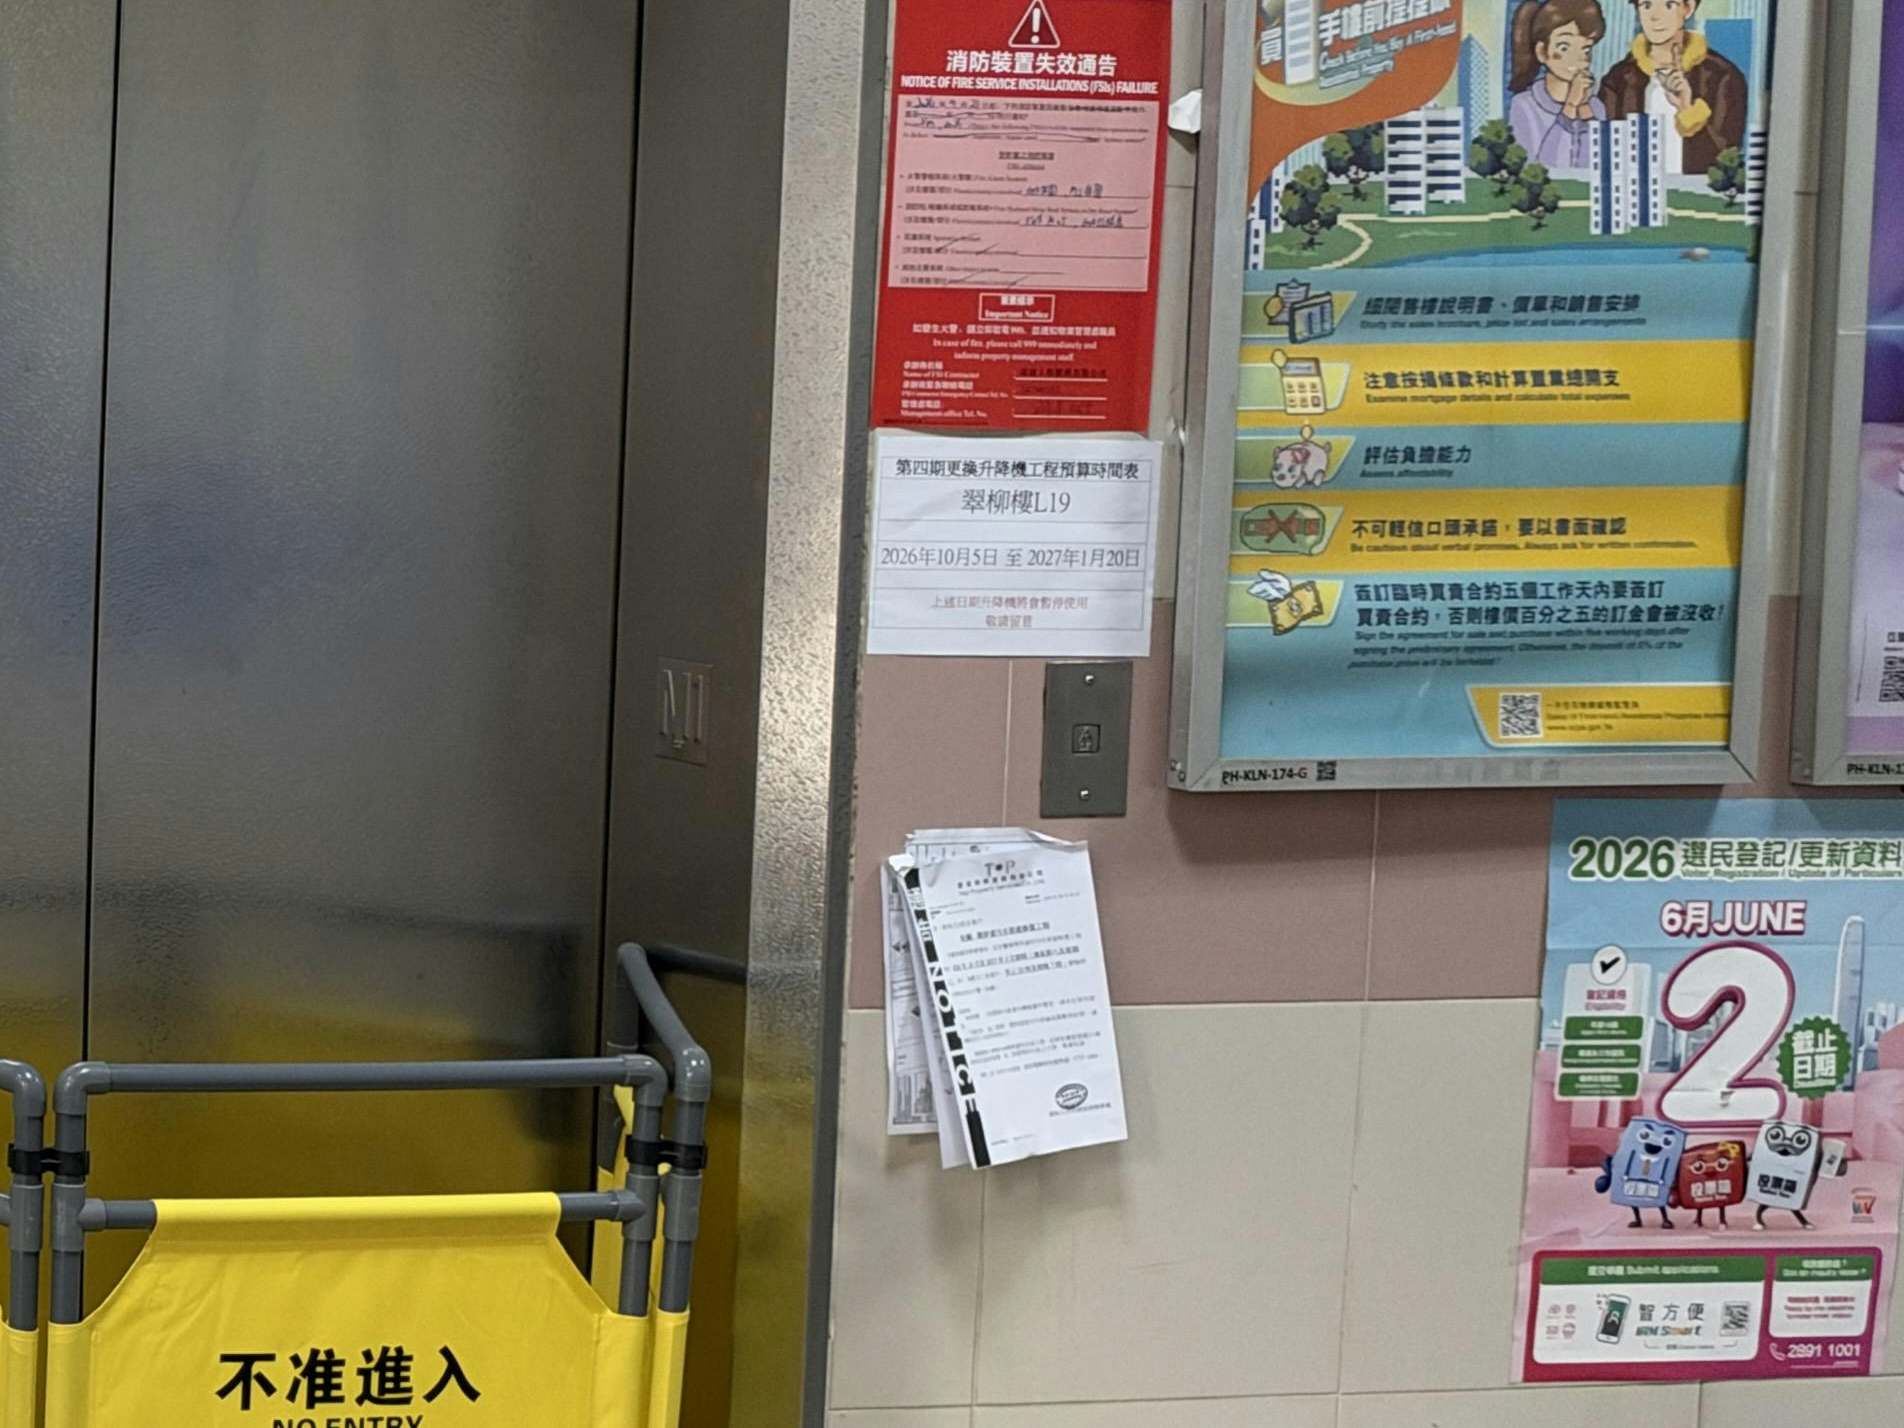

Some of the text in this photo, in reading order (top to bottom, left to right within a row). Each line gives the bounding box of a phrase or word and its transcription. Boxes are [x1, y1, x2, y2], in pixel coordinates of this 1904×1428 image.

[946, 50, 1118, 77] 消防裝置失效通告
[901, 75, 1159, 94] NOTICE OF FIRE SERVICE INSTALLATIONS FAILURE
[896, 458, 1139, 480] 第四期更換升降機工程預算時間表
[961, 489, 1071, 515] 翠柳樓L19
[881, 547, 1140, 568] 2026年10月5日 至 2027年1月20日
[1222, 765, 1308, 786] PH-KLN-174-G
[1570, 839, 1675, 878] 2026
[1681, 840, 1904, 869] 選民登記/更新資料
[1660, 940, 1797, 1128] 2
[1792, 1028, 1838, 1054] 截止
[1793, 1054, 1838, 1080] 日期
[1638, 1302, 1705, 1322] 智方便
[1828, 1343, 1861, 1357] 1001
[215, 1344, 481, 1412] 不准進入
